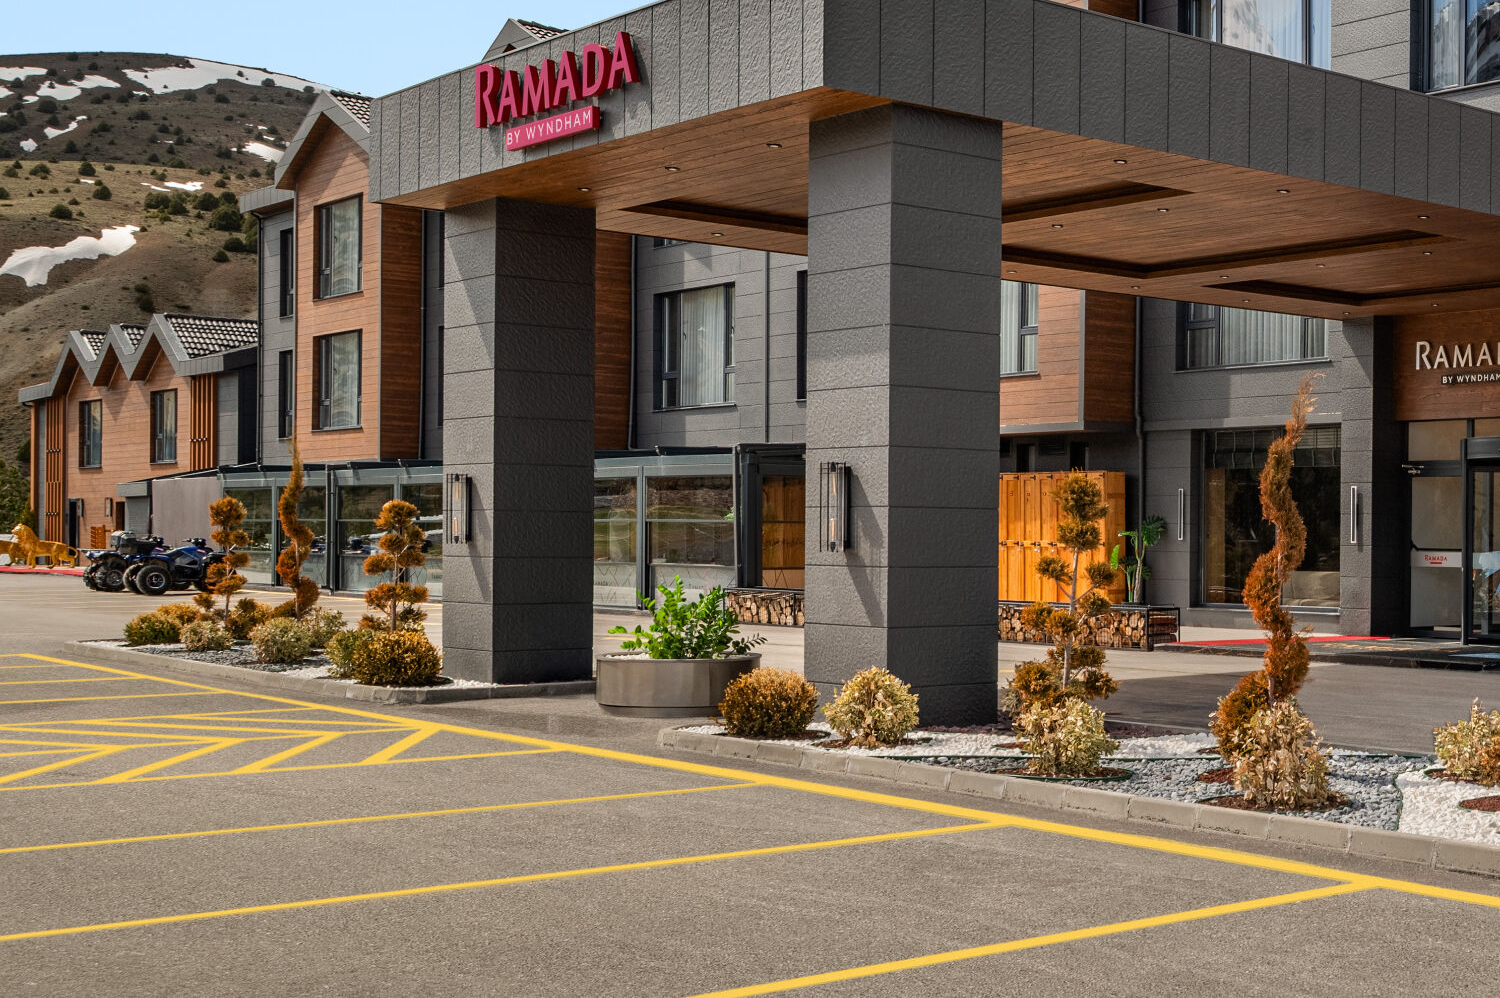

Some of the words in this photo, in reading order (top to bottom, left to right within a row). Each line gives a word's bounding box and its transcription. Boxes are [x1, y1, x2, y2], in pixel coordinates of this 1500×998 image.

[475, 31, 640, 128] RAMADA
[506, 130, 521, 146] BY
[526, 111, 591, 140] WYNDHAM
